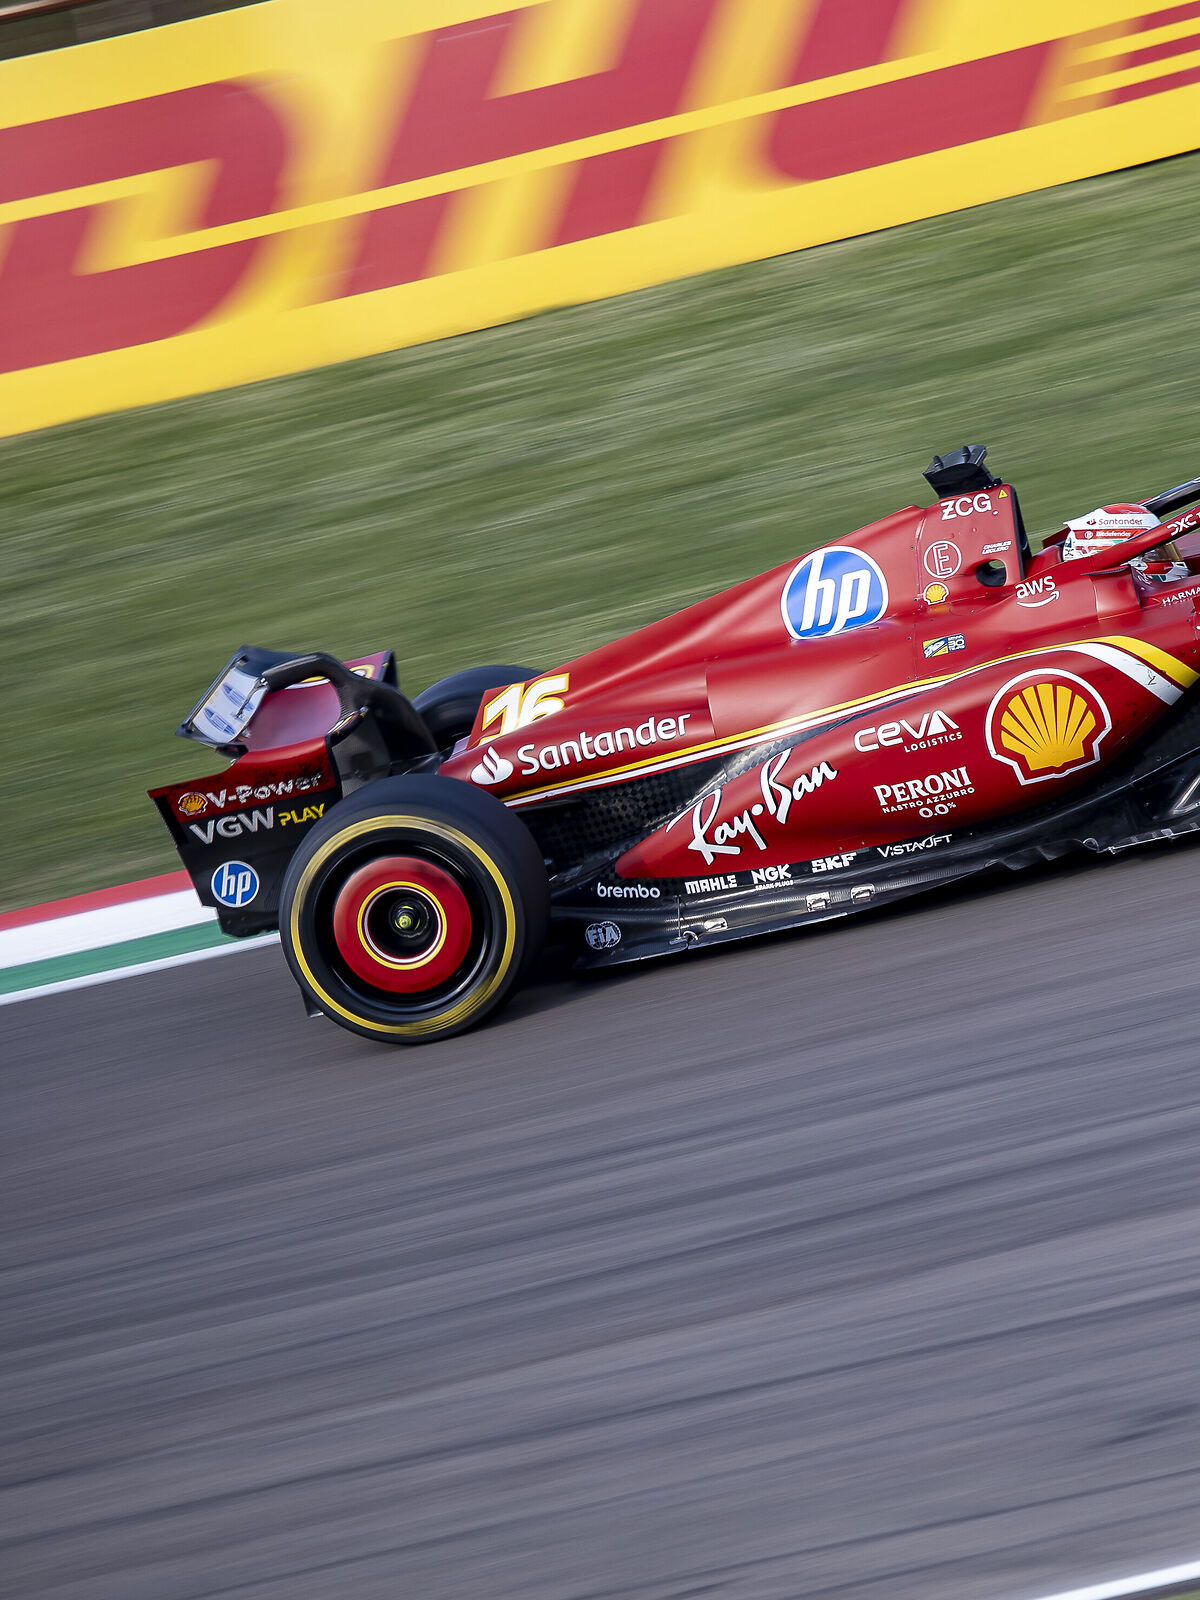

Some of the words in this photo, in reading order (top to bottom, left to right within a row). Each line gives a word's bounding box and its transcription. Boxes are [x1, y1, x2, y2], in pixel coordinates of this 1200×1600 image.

[0, 0, 1060, 375] DHL
[1167, 513, 1197, 536] DXC
[981, 545, 1009, 555] LECLERC
[983, 540, 1012, 550] CHARLES
[799, 547, 872, 638] hp
[1015, 575, 1056, 599] aws
[478, 672, 571, 745] 16
[516, 712, 691, 776] Santander
[904, 731, 963, 753] LOGISTICS
[873, 766, 972, 806] PERONI
[882, 800, 924, 813] NASTRO
[926, 787, 975, 804] AZZURRO
[918, 802, 957, 818] 0.0%
[189, 806, 274, 845] VGW
[278, 803, 325, 827] PLAY
[751, 863, 792, 885] NGK
[812, 852, 857, 873] SKF
[220, 862, 252, 907] hp
[597, 882, 661, 899] brembo
[684, 874, 738, 895] MAHLE
